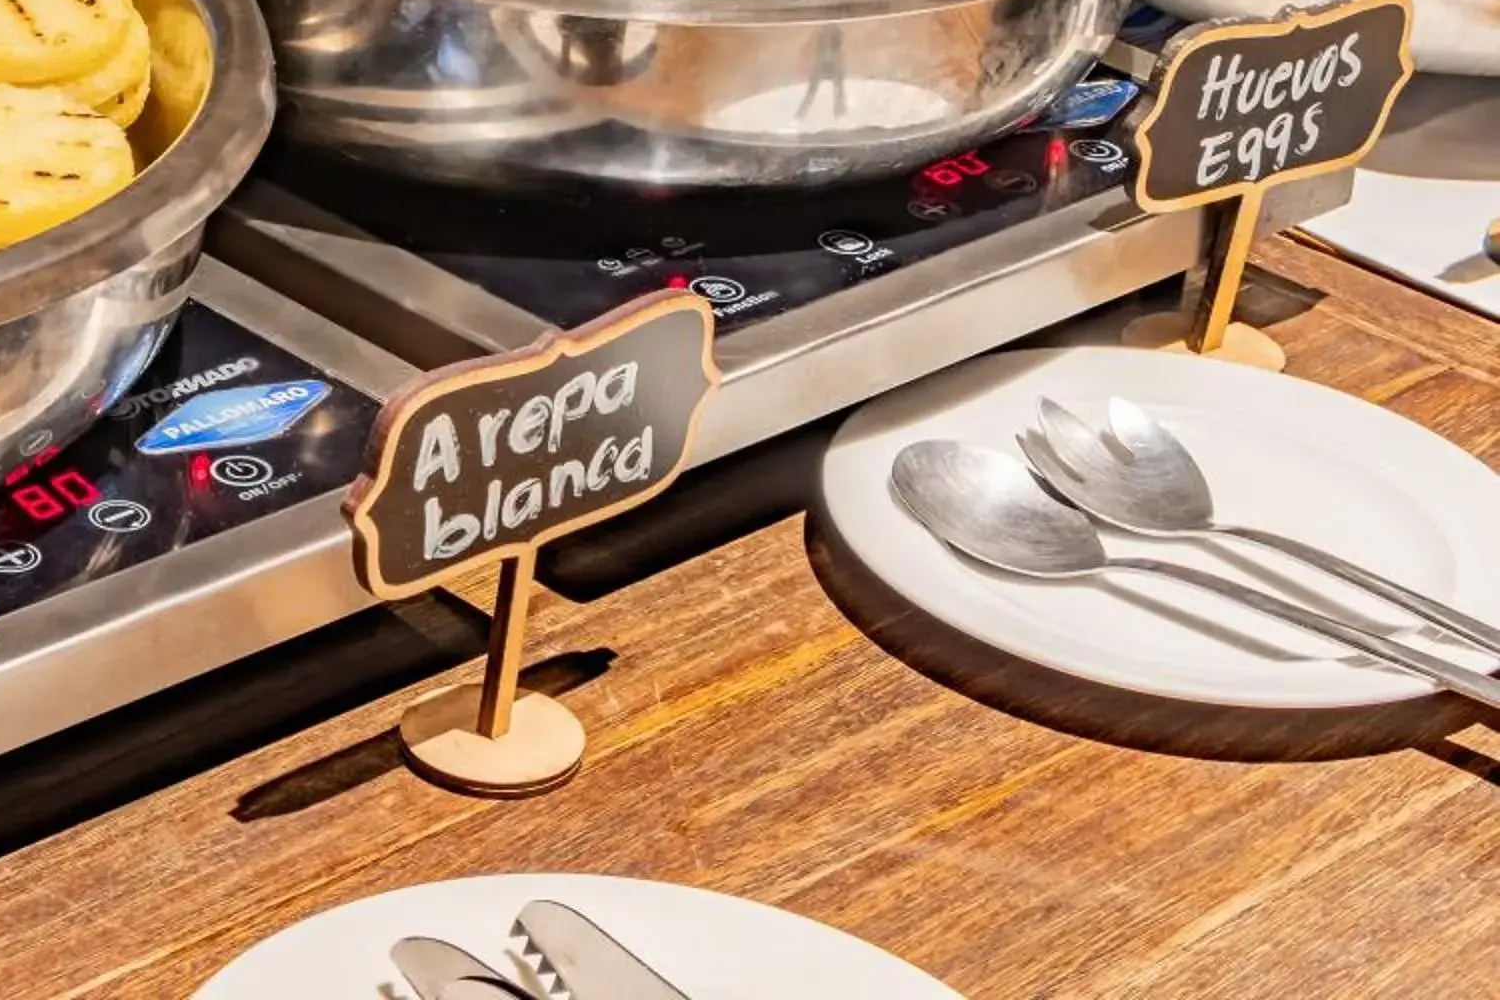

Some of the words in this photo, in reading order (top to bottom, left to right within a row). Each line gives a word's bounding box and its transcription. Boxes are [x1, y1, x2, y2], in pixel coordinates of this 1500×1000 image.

[135, 356, 261, 404] TORNADO
[162, 385, 310, 440] PALLOMARO
[11, 470, 102, 520] 80
